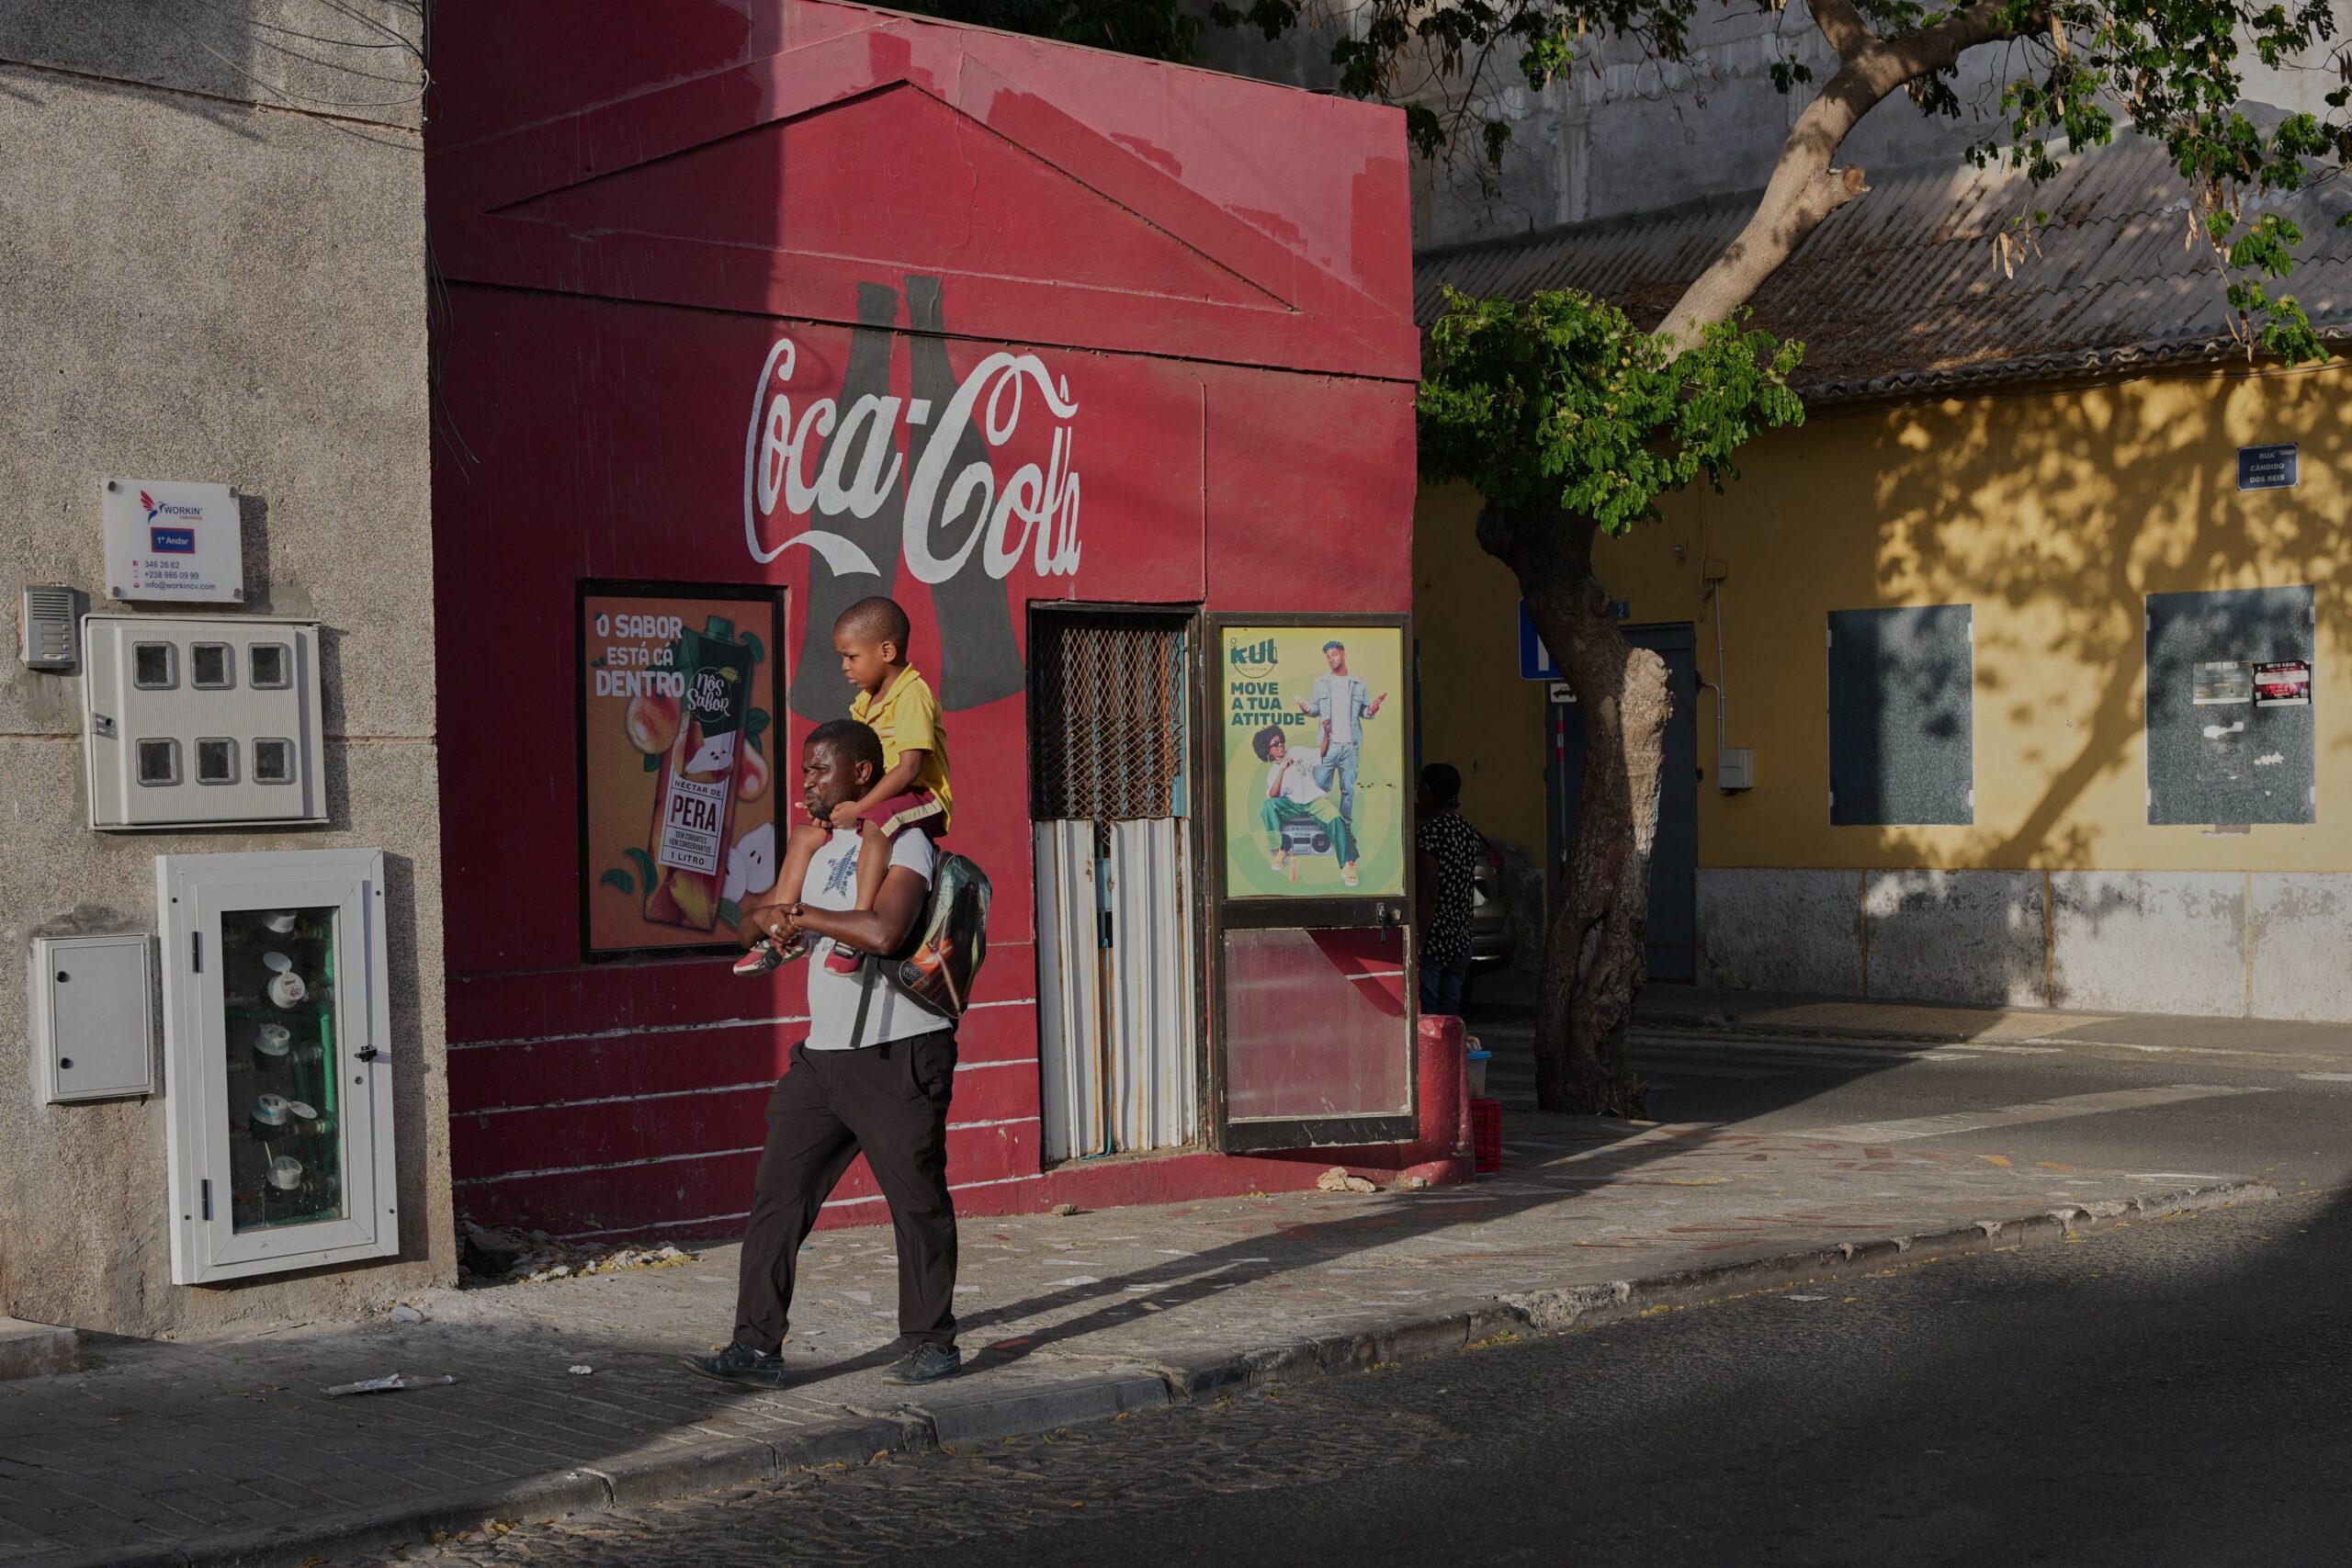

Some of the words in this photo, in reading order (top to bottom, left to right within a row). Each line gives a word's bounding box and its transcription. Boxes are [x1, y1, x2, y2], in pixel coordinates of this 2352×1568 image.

[744, 338, 1081, 584] Coca-Cola
[2250, 462, 2285, 471] CÂNDIDO
[2267, 474, 2285, 482] REIS
[166, 536, 189, 545] Andar
[144, 581, 216, 591] info@workincv.com
[1618, 604, 1624, 617] 2
[596, 614, 610, 637] O
[615, 614, 683, 638] SABOR
[607, 641, 650, 666] ESTÁ
[653, 641, 673, 666] CÁ
[596, 670, 684, 697] DENTRO
[1230, 682, 1279, 695] MOVE
[1231, 696, 1244, 710] A
[1247, 696, 1283, 710] TUA
[1231, 712, 1306, 726] ATITUDE
[710, 788, 722, 797] DE
[670, 794, 717, 832] PERA
[669, 837, 679, 846] NEM
[675, 830, 685, 839] SEM
[685, 832, 707, 844] CORANTES
[678, 852, 705, 865] LITRO
